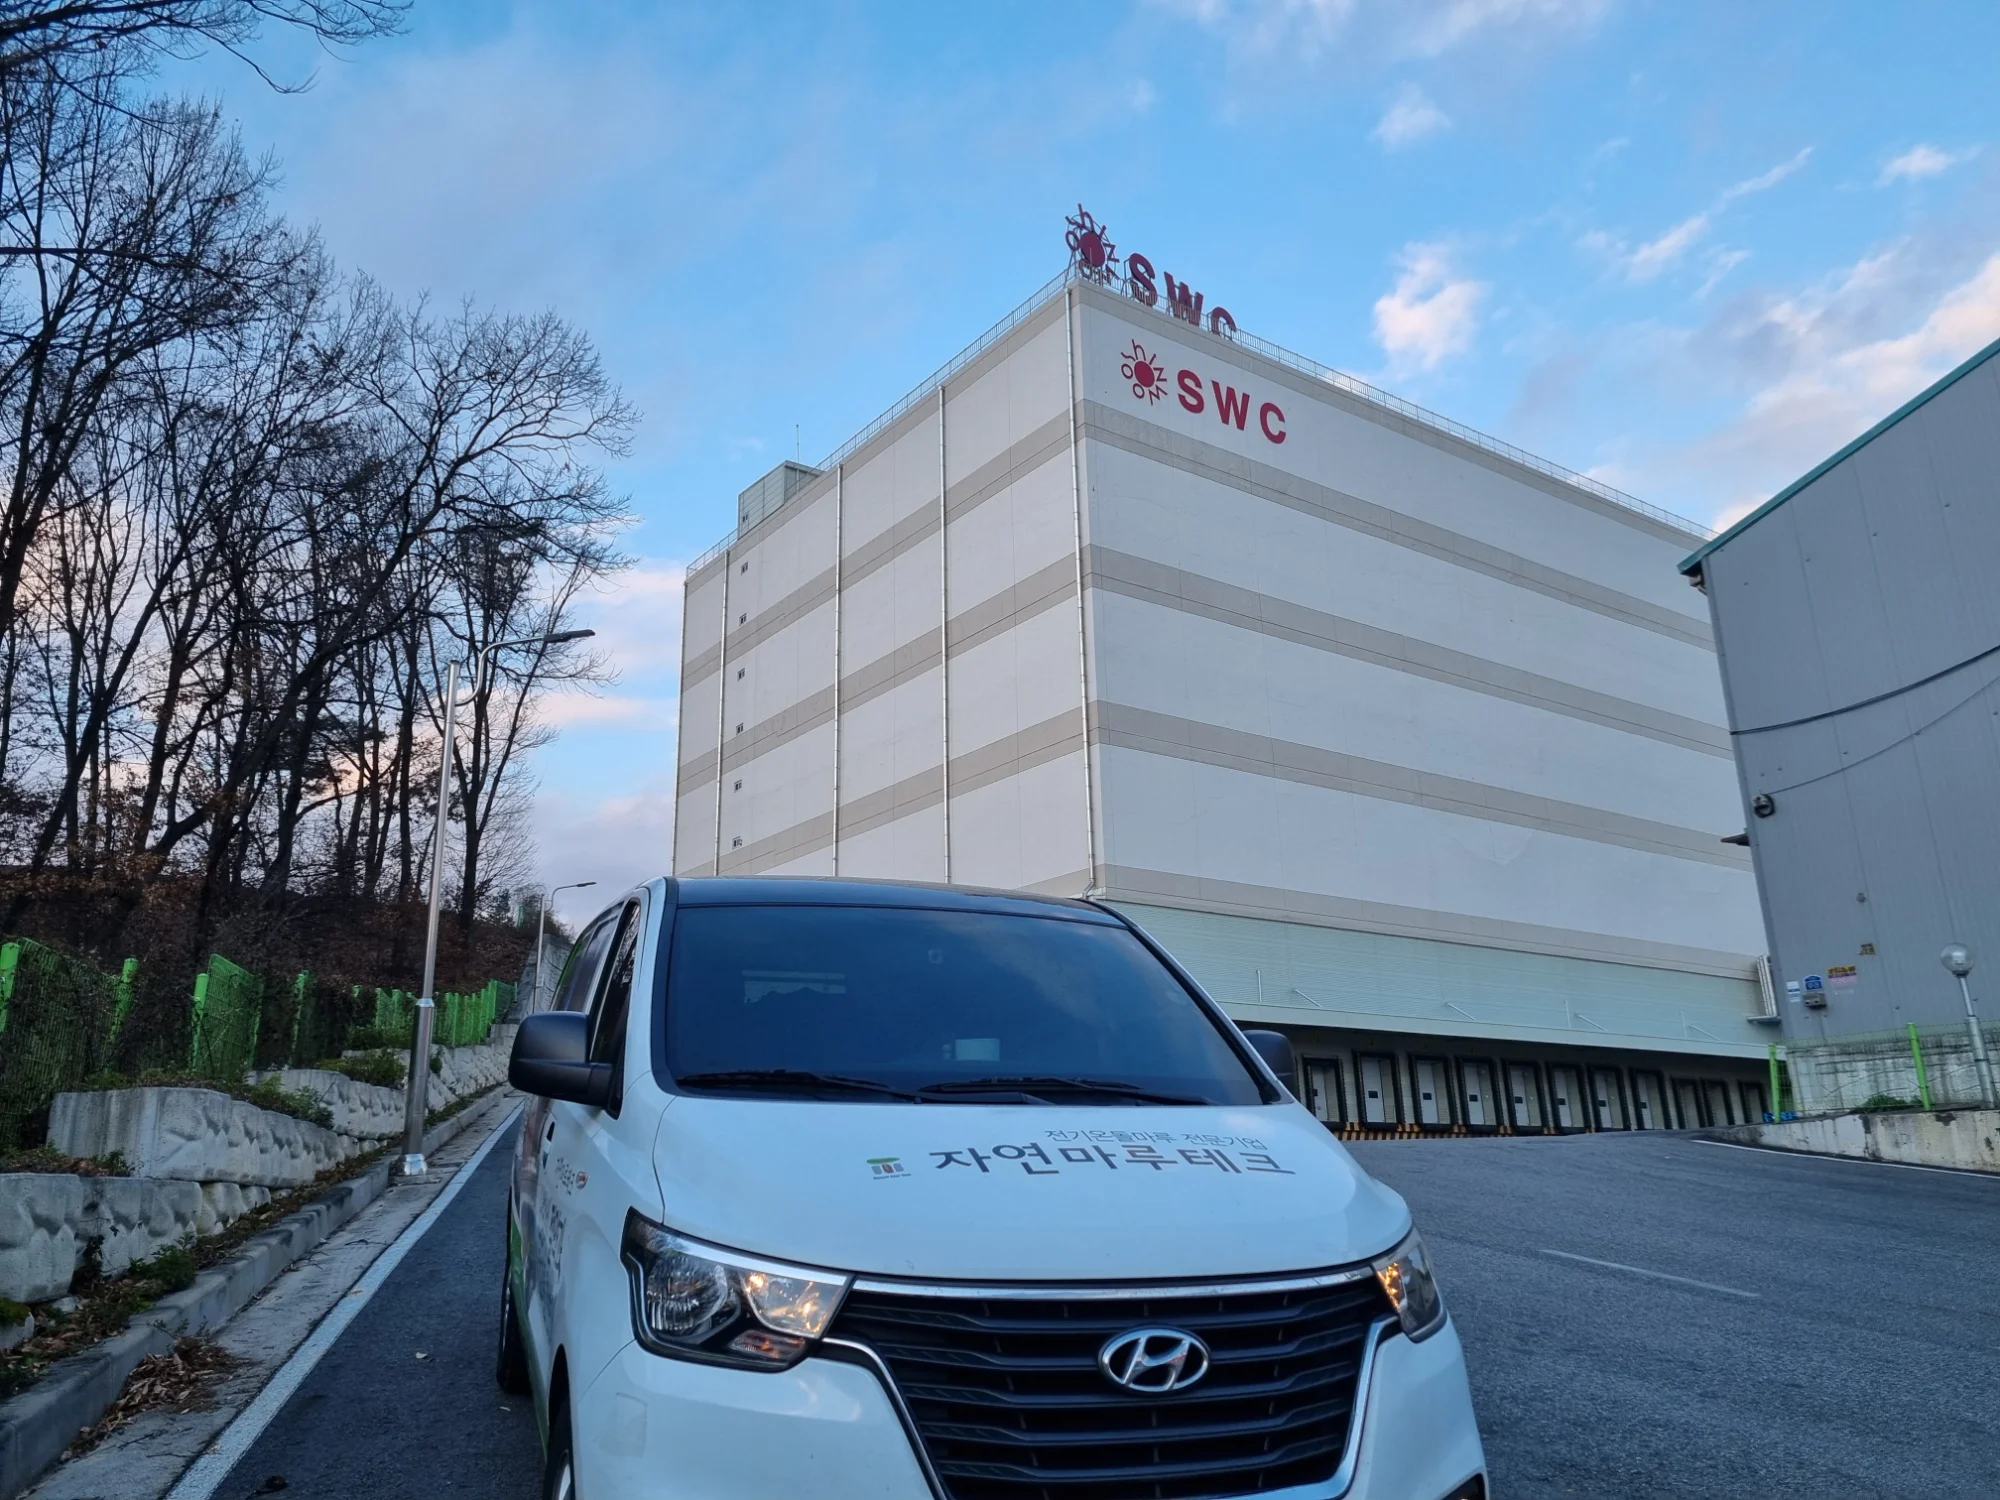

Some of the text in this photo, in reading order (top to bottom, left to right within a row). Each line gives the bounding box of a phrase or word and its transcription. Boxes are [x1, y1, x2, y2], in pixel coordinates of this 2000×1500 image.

[1129, 252, 1236, 342] SWC
[1176, 369, 1287, 444] SWC
[928, 1141, 1296, 1176] 자연마루테크
[1045, 1129, 1268, 1151] 전기온돌마루 전문기업
